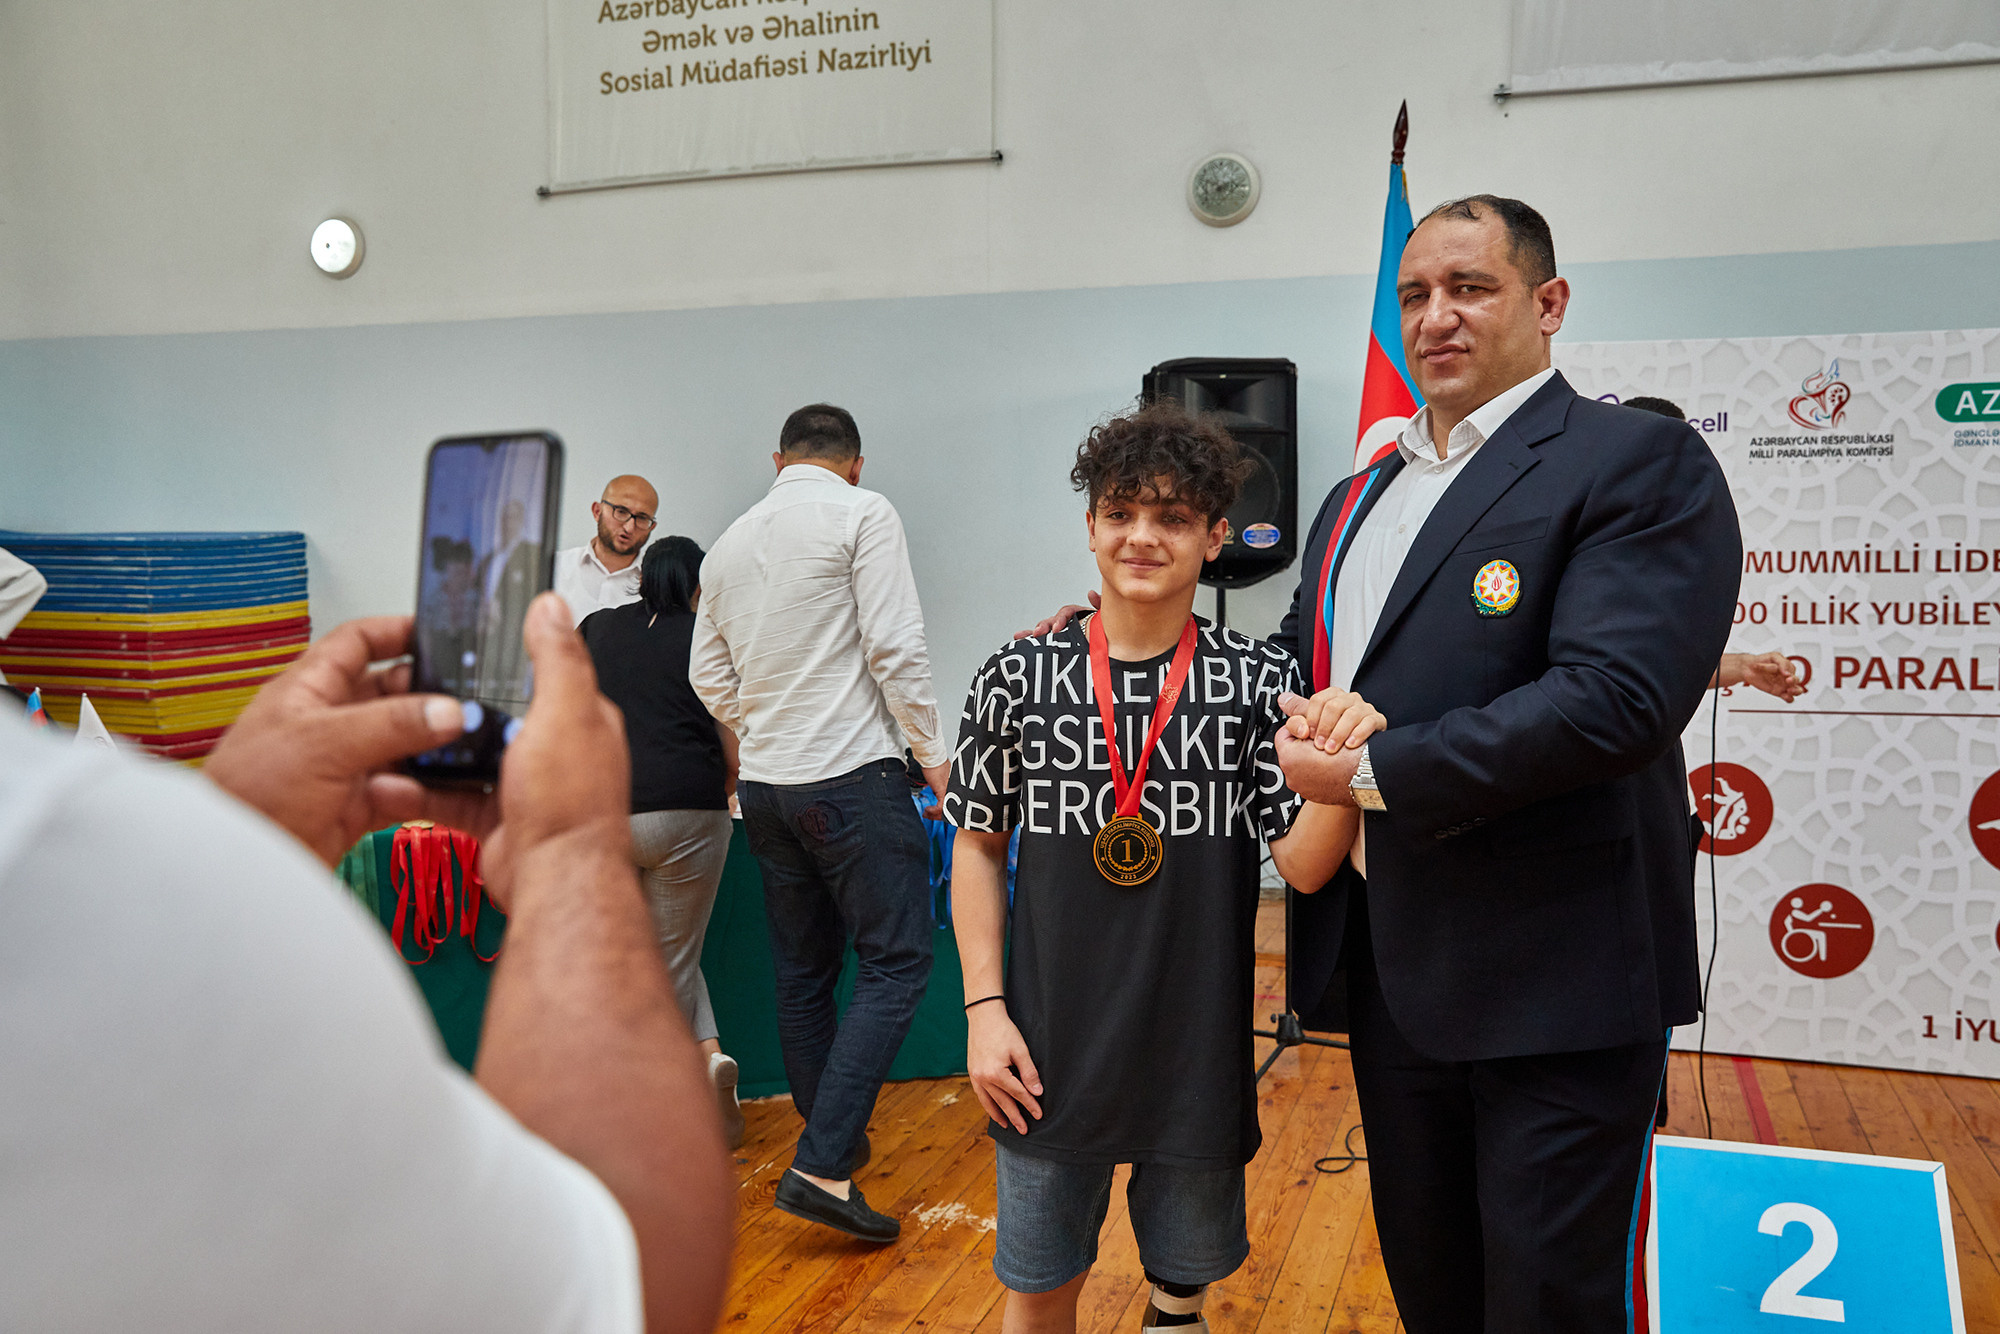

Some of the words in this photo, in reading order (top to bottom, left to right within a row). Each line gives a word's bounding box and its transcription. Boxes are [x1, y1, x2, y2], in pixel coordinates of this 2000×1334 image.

[642, 23, 717, 53] Əmək
[724, 25, 754, 44] və
[762, 7, 880, 40] Əhalinin
[600, 64, 673, 95] Sosial
[681, 51, 808, 86] Müdafiəsi
[816, 39, 932, 72] Nazirliyi
[1750, 436, 1818, 446] AZƏRBAYCAN
[1745, 543, 1920, 574] MUMMİLLİ
[1782, 595, 1860, 625] İLLİK
[1834, 656, 2000, 691] PARAL
[1121, 839, 1134, 863] 1
[1922, 1015, 1938, 1038] 1
[1757, 1202, 1845, 1323] 2
